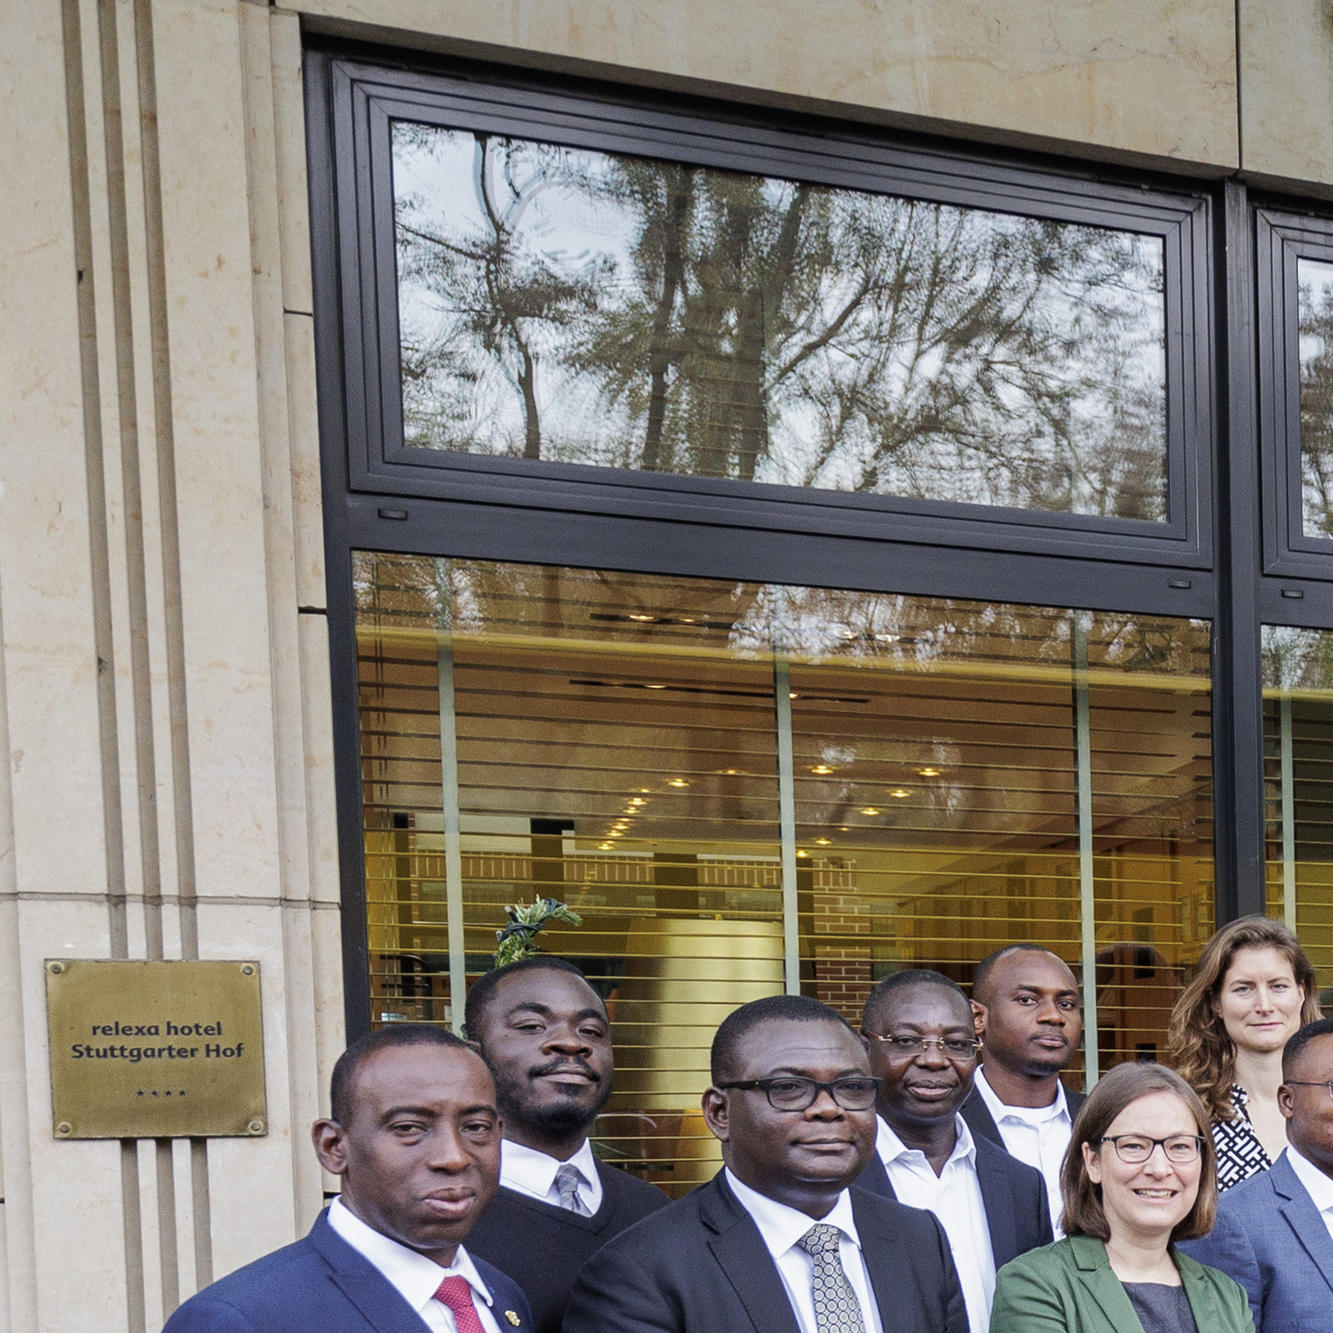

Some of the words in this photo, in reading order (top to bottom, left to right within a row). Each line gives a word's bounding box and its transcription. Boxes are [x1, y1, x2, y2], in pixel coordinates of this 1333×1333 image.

[91, 1020, 160, 1036] relexa
[165, 1020, 223, 1036] hotel
[71, 1043, 199, 1062] Stuttgarter
[204, 1042, 245, 1059] Hof
